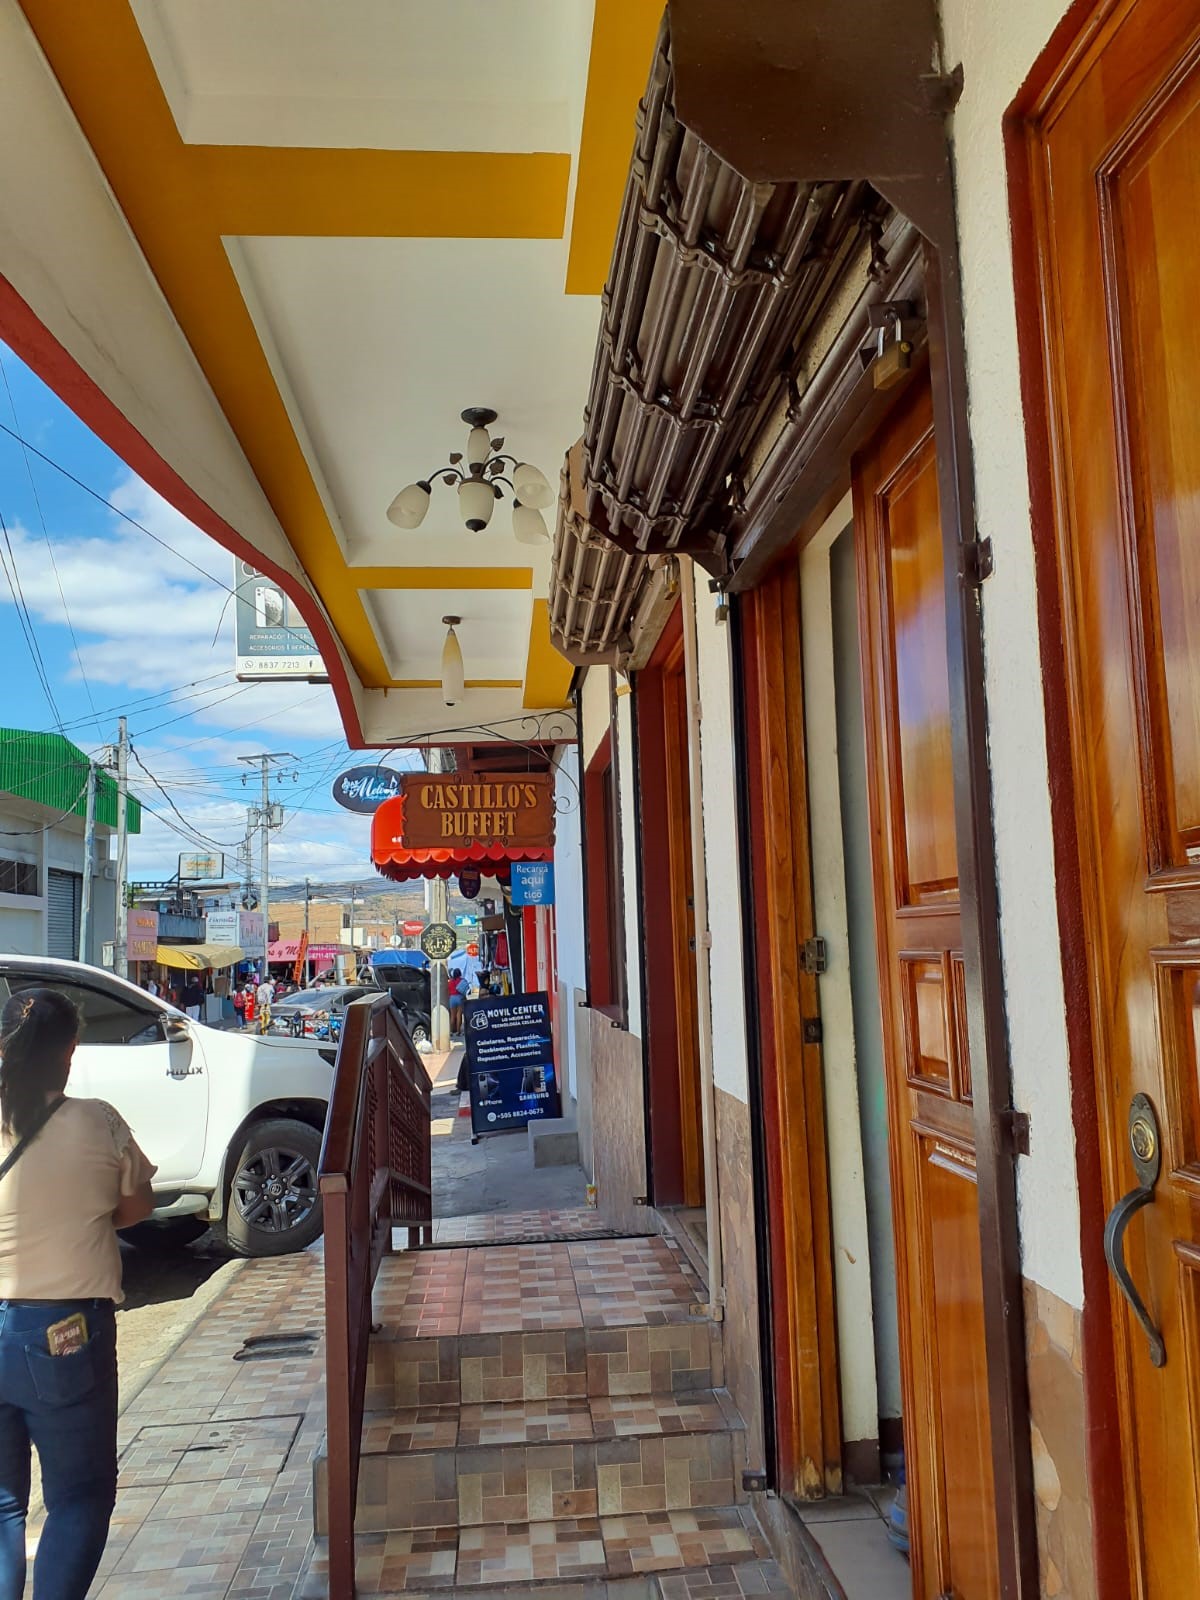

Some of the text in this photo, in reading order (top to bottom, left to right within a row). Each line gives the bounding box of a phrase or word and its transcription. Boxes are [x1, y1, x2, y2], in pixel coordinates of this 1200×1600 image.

[282, 661, 300, 669] 7213
[420, 784, 538, 810] CASTILLO'S
[440, 811, 517, 837] BUFFET
[516, 864, 549, 874] Recarga
[521, 874, 544, 887] aquí
[523, 890, 543, 902] tigo
[487, 1004, 544, 1018] MOVIL CENTER
[165, 1066, 203, 1077] HILUX
[518, 1092, 550, 1101] SAMSUNG
[496, 1112, 512, 1120] +505
